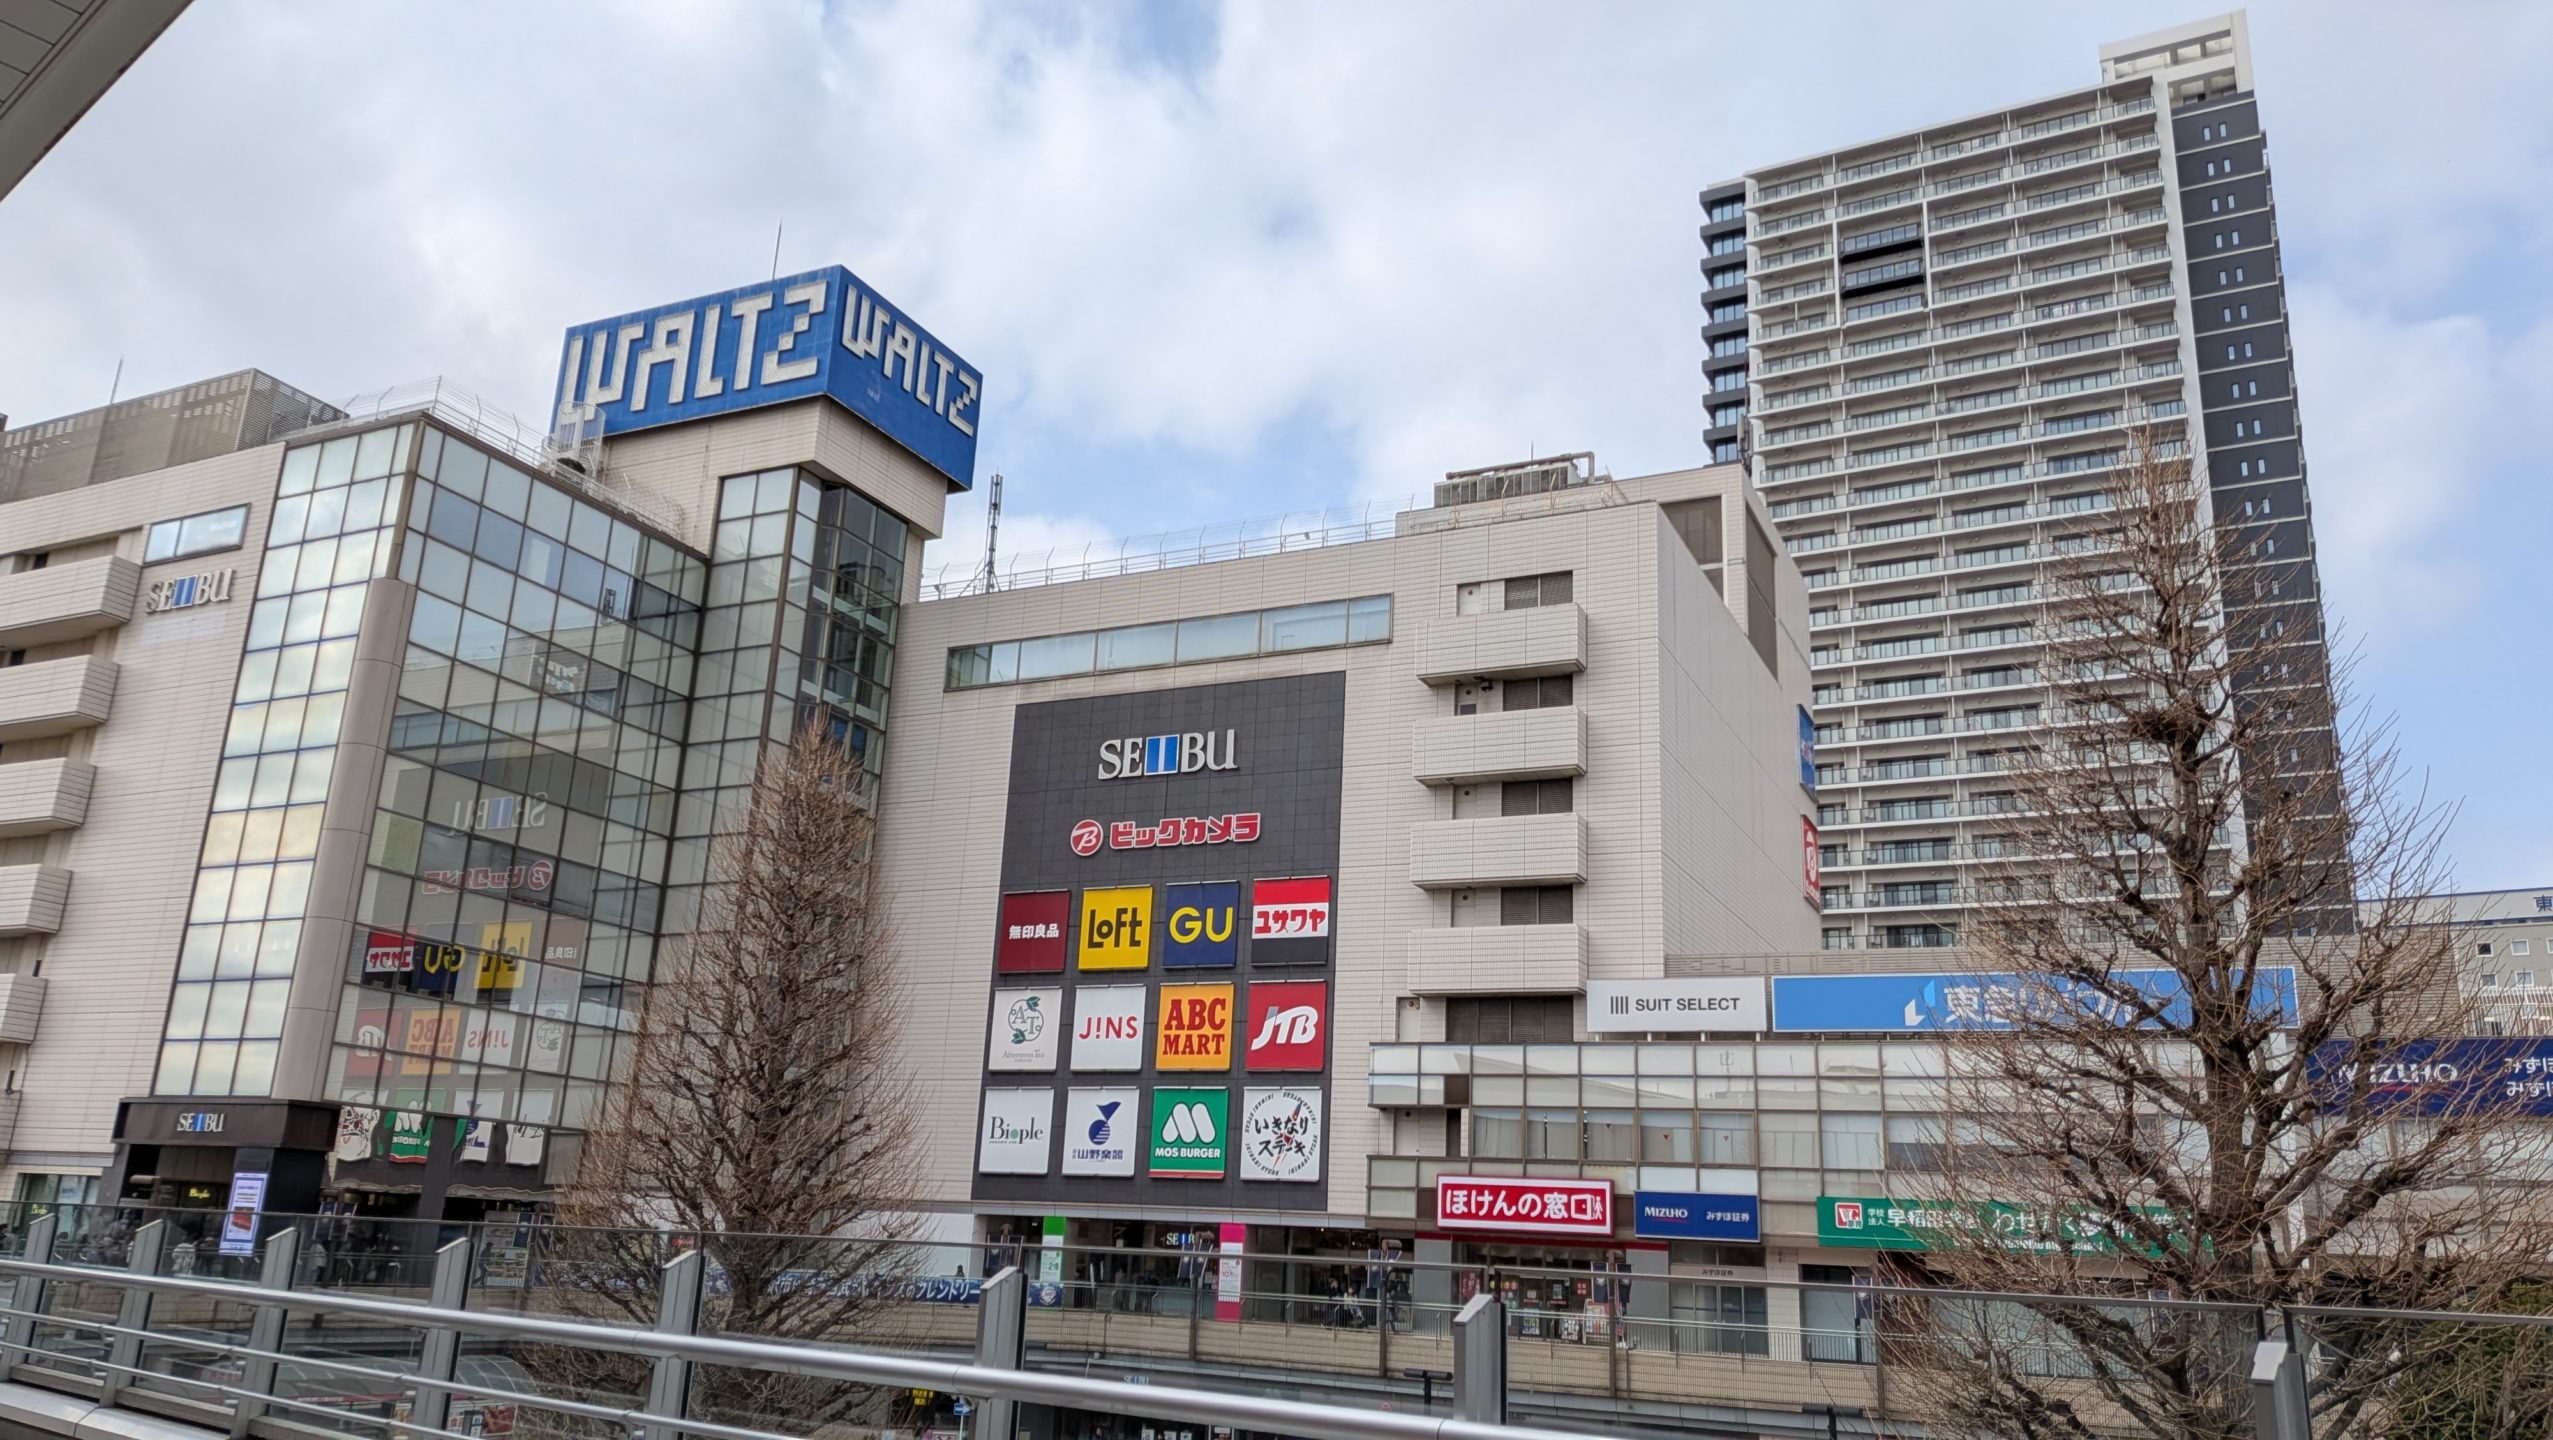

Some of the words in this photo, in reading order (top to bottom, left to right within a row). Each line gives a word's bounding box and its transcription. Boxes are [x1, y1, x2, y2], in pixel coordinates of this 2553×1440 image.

[841, 283, 979, 437] WALTZ
[146, 567, 234, 614] SEIBU
[1098, 729, 1239, 780] SEIBU
[1110, 813, 1261, 850] ビックカメラ
[1009, 923, 1060, 940] 無印良品
[1169, 906, 1233, 944] GU
[1254, 908, 1326, 935] ユサワヤ
[1164, 998, 1227, 1031] ABC
[1635, 998, 1672, 1012] SUIT
[1676, 997, 1740, 1011] SELECT
[1251, 1006, 1318, 1051] JTB
[1163, 1034, 1226, 1056] MART
[177, 1113, 225, 1132] SEIBU
[1254, 1114, 1308, 1135] いきなり
[1155, 1147, 1178, 1158] MOS
[1180, 1147, 1221, 1159] BURGER
[1258, 1138, 1306, 1158] ステーキ
[1644, 1206, 1688, 1218] MIZUHO
[1706, 1211, 1750, 1222] みずほ証券
